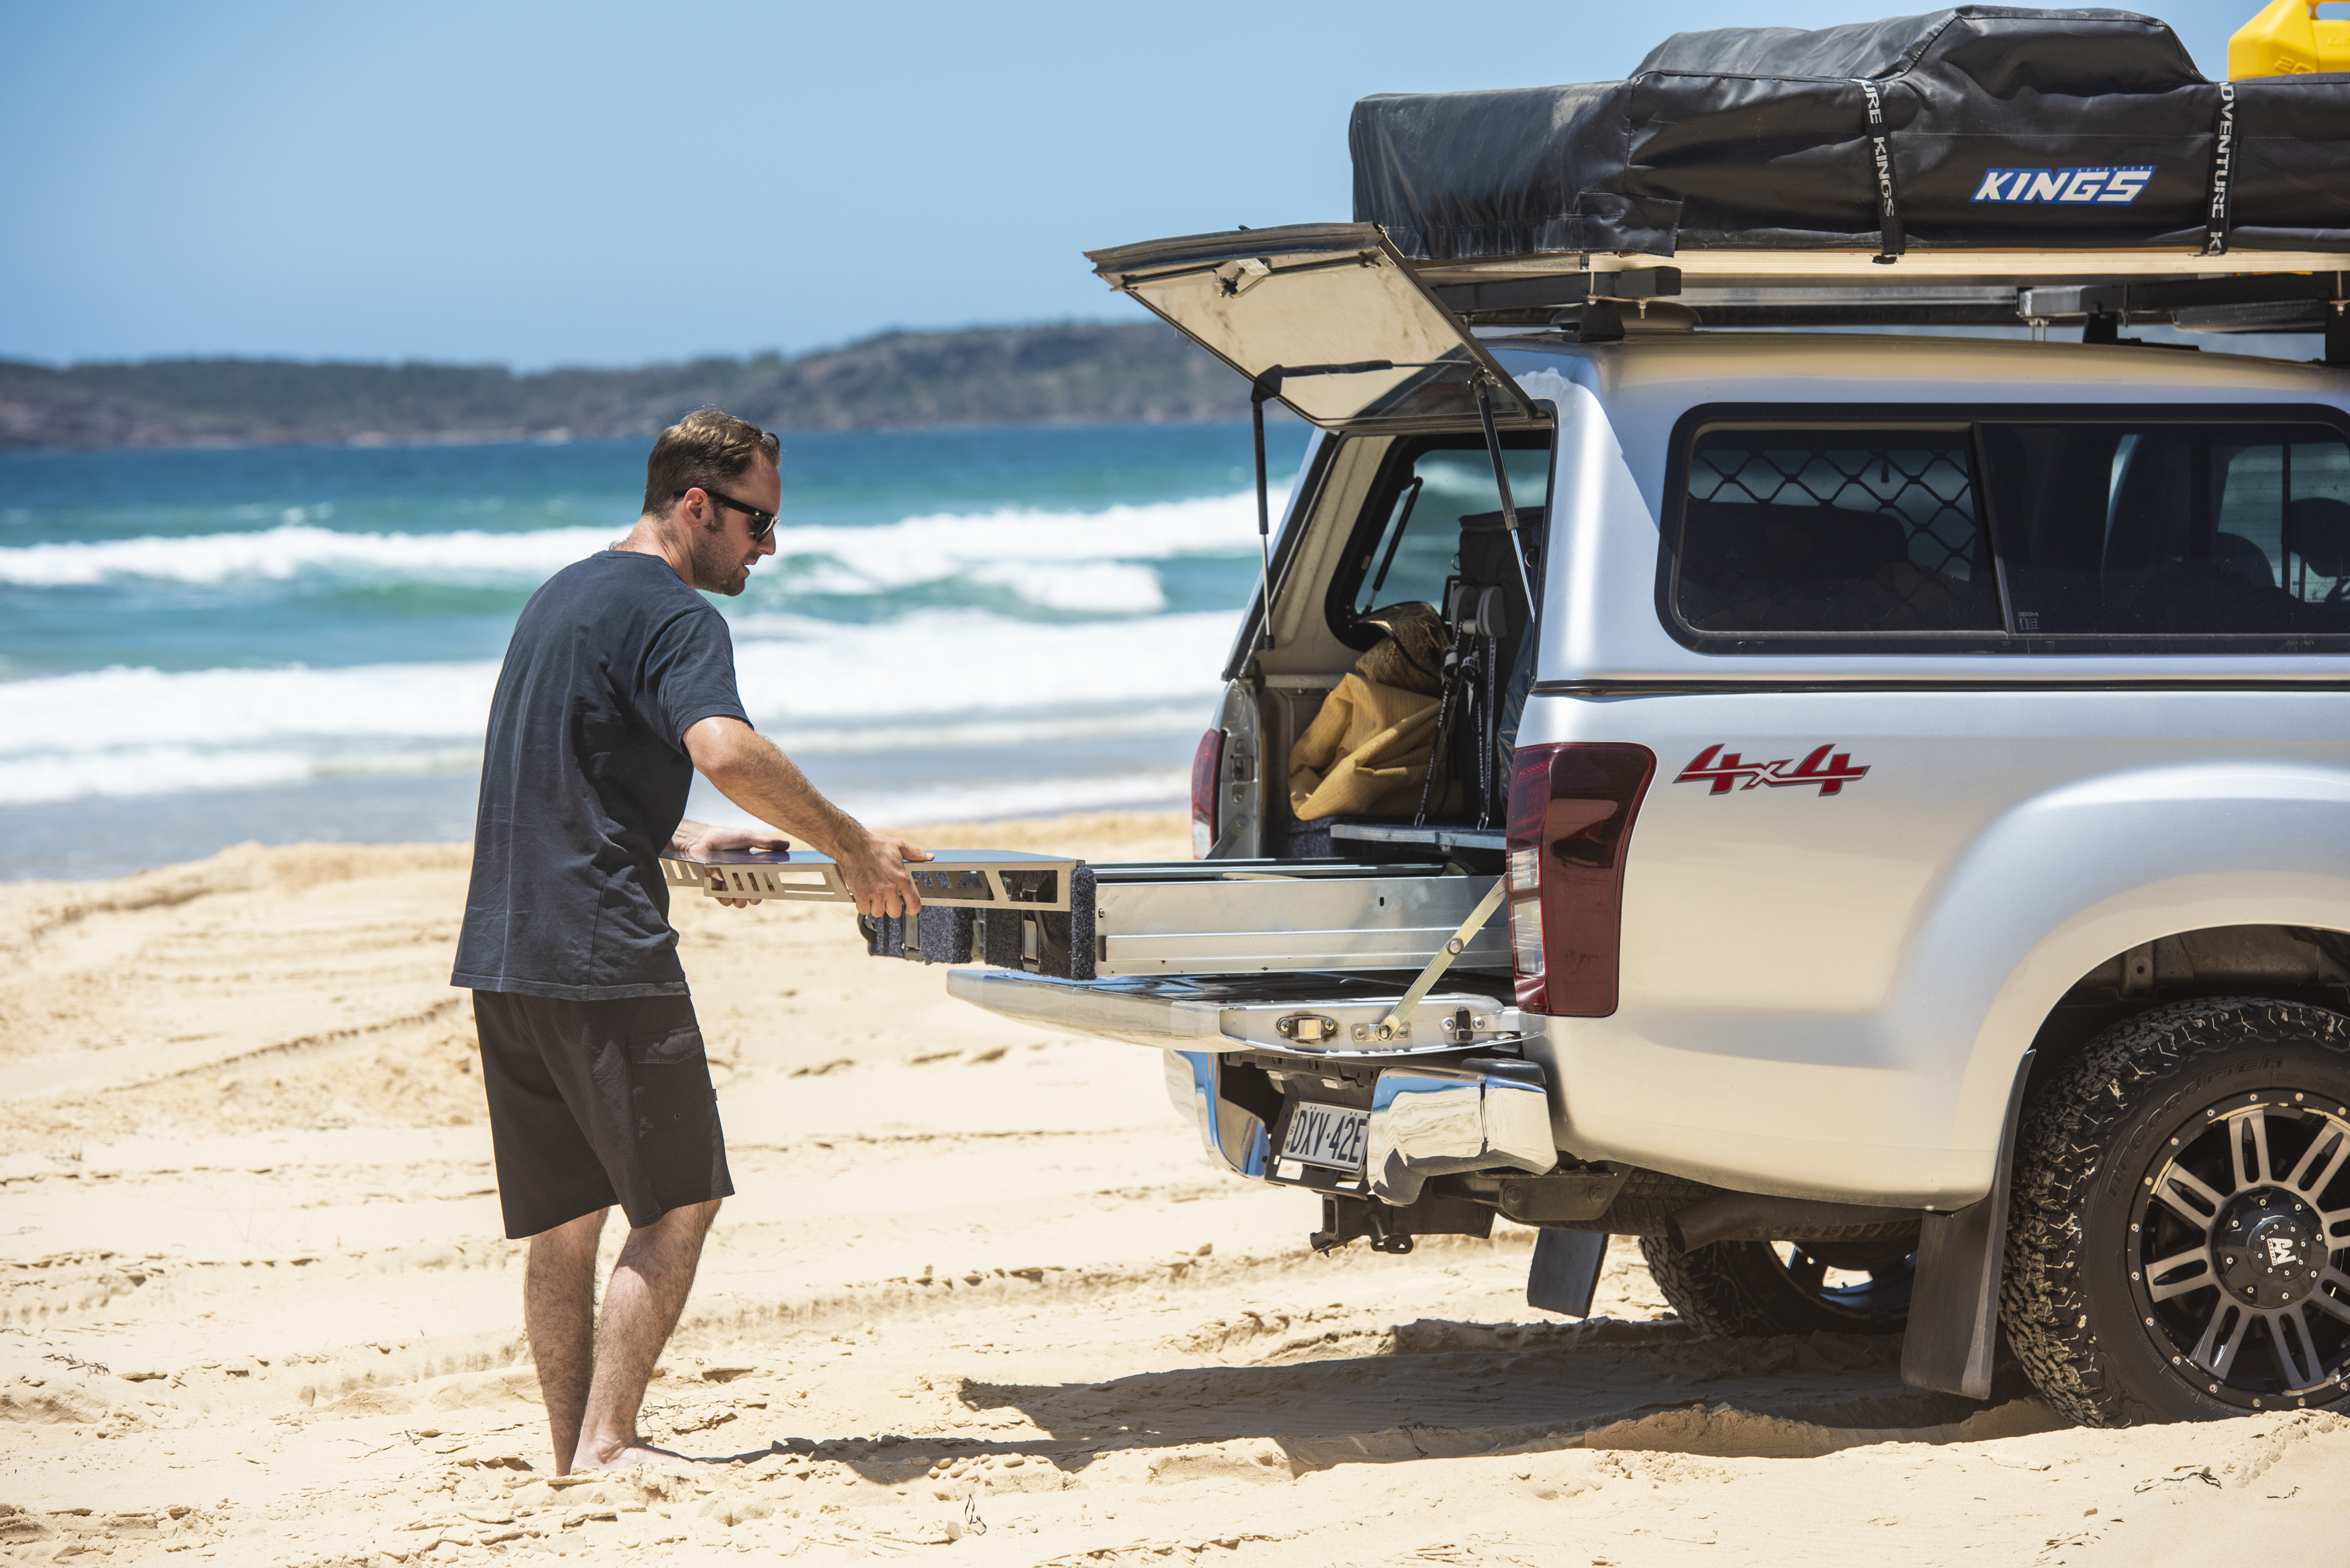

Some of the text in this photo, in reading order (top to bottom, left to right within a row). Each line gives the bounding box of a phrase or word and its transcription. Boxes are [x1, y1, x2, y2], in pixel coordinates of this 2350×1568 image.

[1873, 137, 1894, 217] KINGS
[1974, 172, 2152, 201] KINGS
[2077, 165, 2153, 173] ADVENTURE
[1672, 744, 1872, 797] 4x4
[2106, 1051, 2284, 1198] BFGoodrich
[2267, 1239, 2277, 1265] ALLIED
